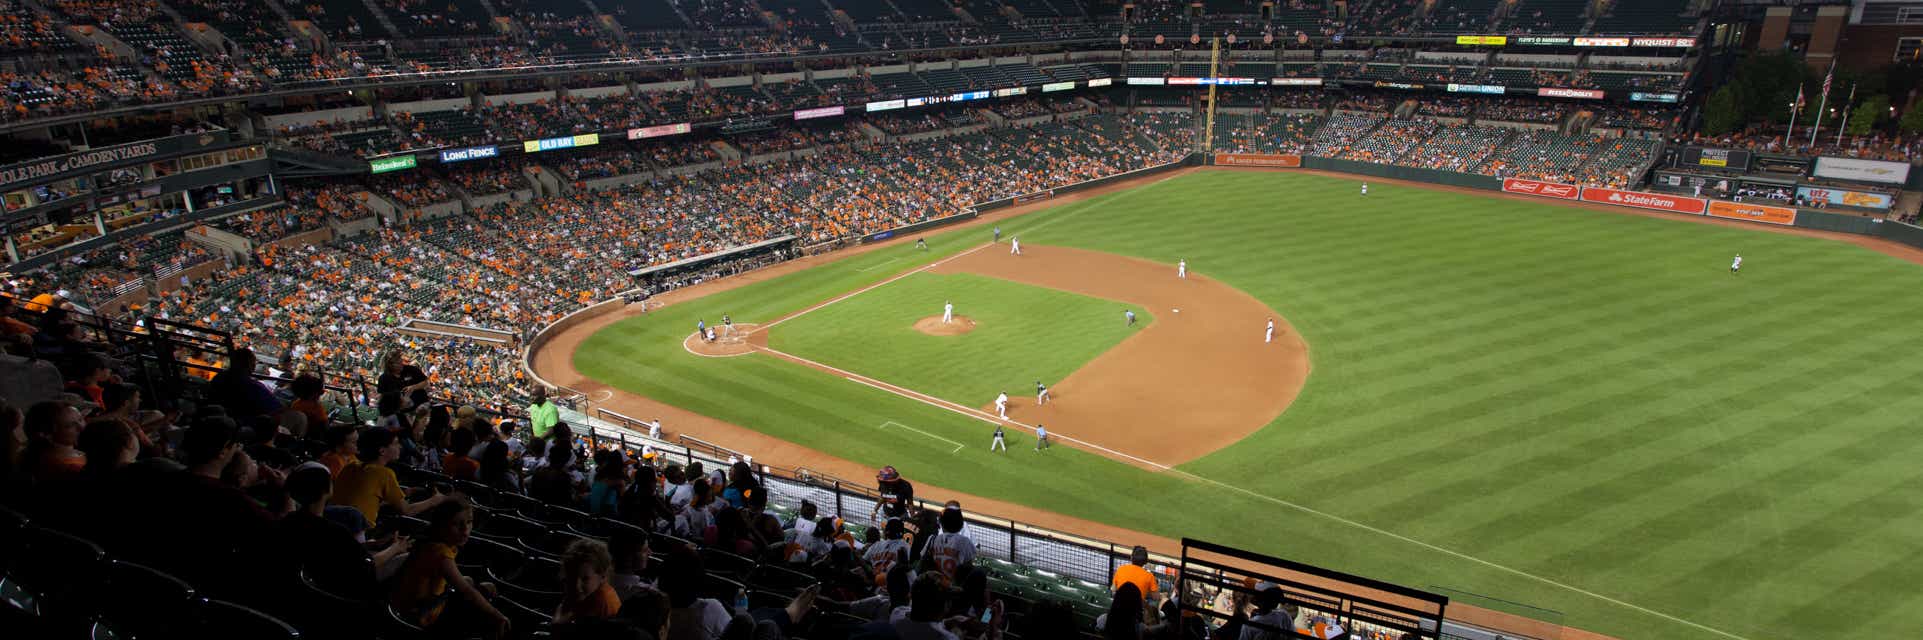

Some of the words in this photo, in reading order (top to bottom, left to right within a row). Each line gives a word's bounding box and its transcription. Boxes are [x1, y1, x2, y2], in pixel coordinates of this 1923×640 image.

[541, 139, 557, 149] OLD
[557, 137, 573, 147] BAY
[28, 161, 61, 178] PARK
[68, 149, 119, 169] CAMDEN
[118, 143, 156, 160] YARDS
[443, 150, 467, 161] LONG
[468, 147, 495, 158] FENCE
